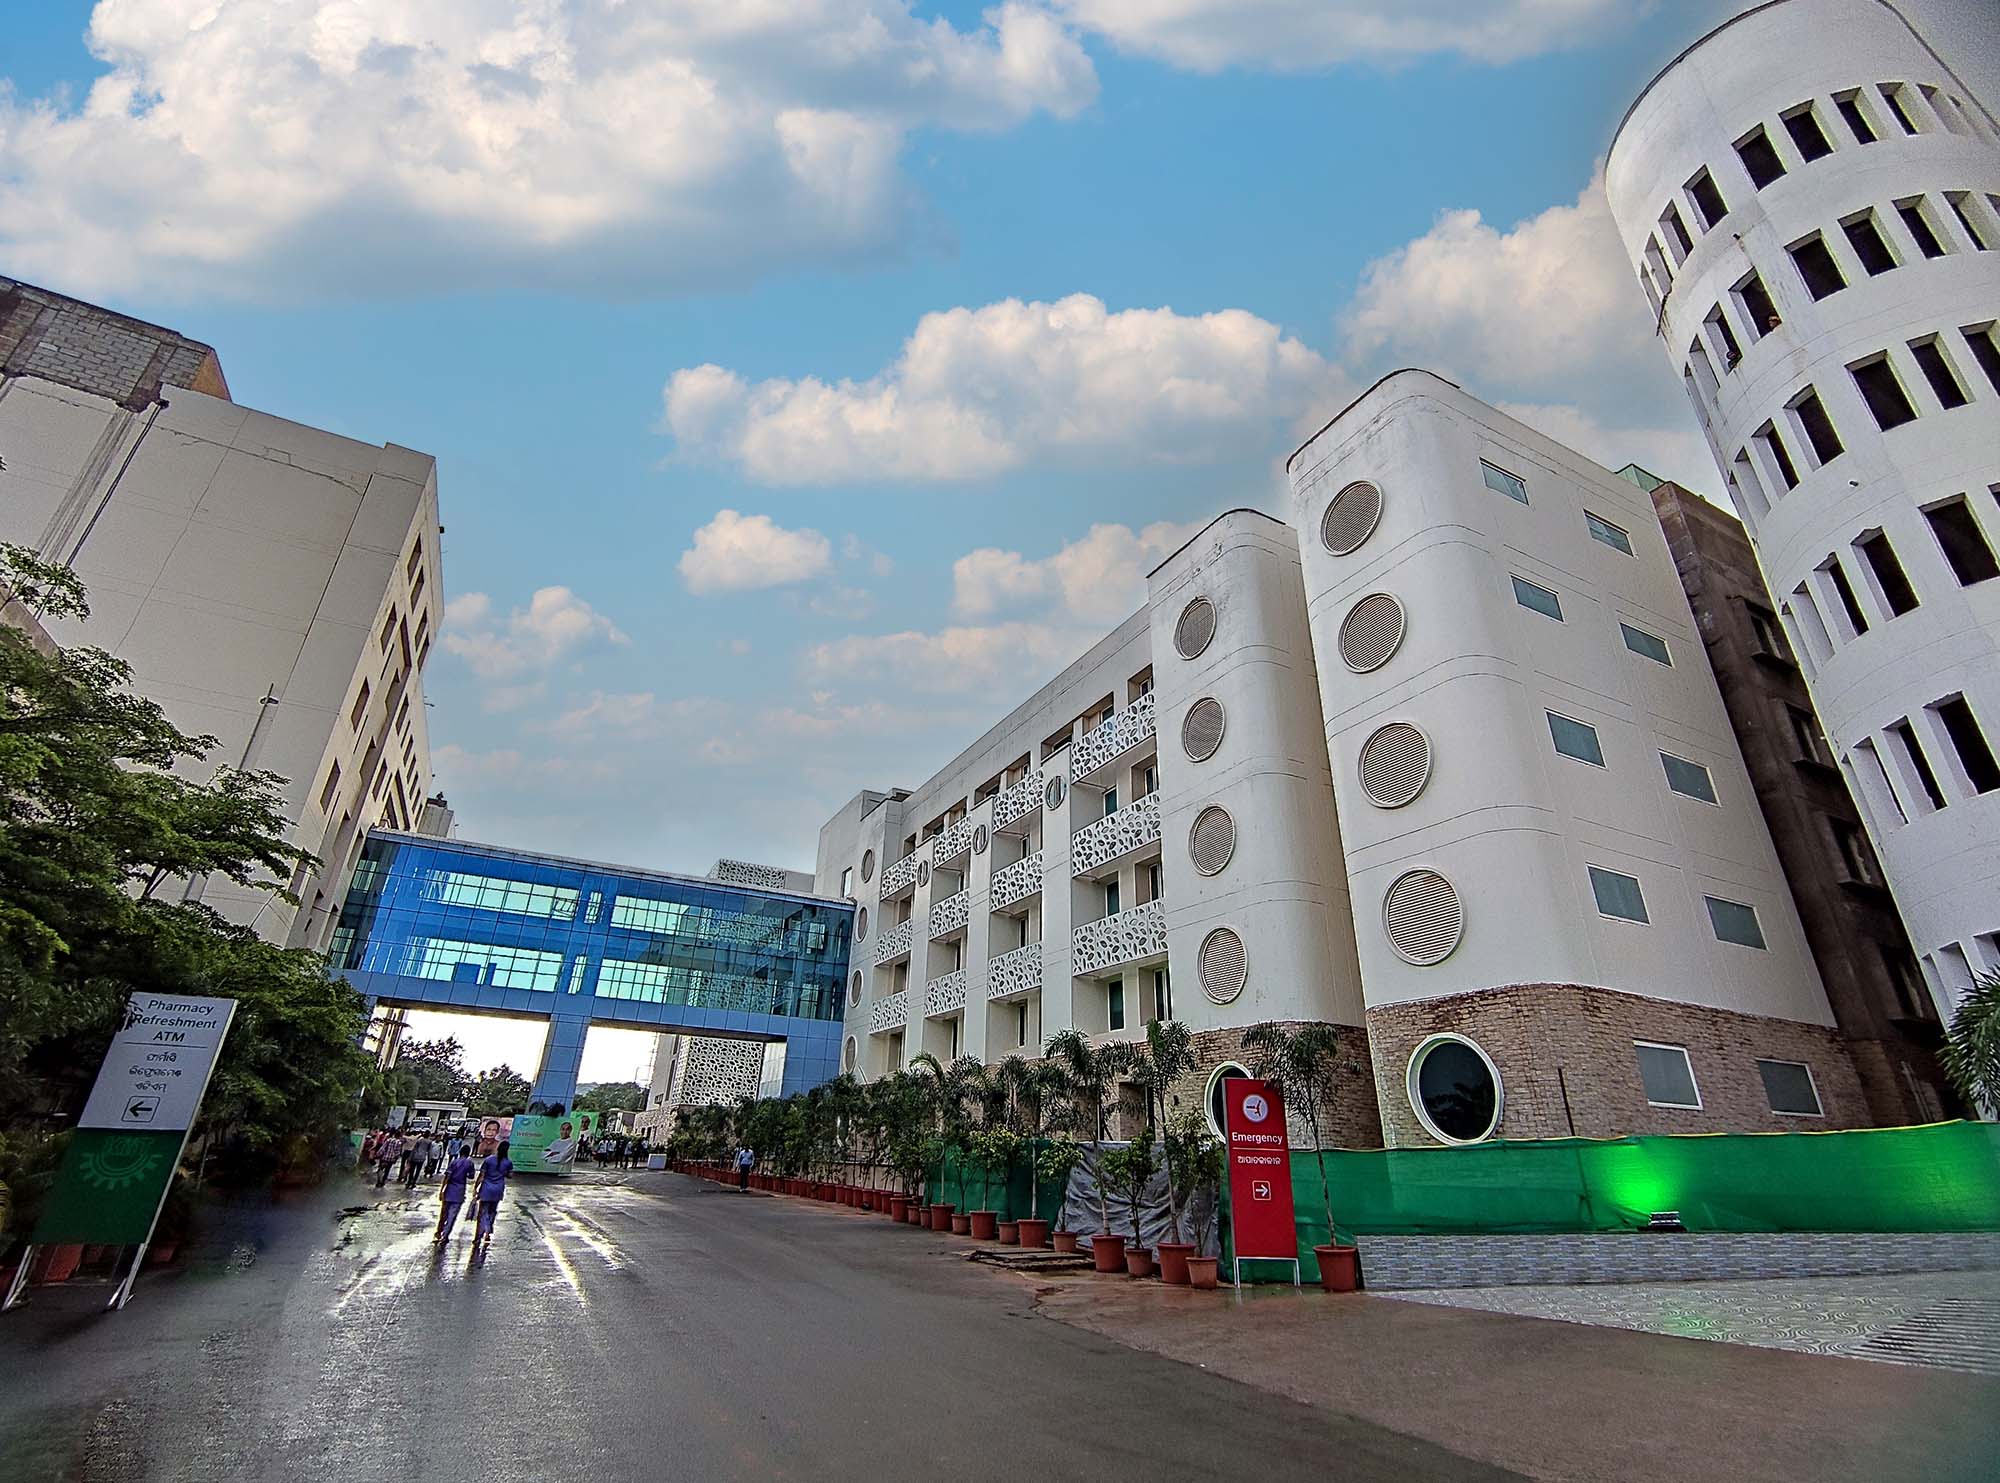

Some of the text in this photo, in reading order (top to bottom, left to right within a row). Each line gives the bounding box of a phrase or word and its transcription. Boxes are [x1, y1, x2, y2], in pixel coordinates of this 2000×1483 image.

[148, 1000, 214, 1016] Pharmacy
[134, 1014, 217, 1029] Refreshment
[153, 1031, 185, 1042] ATM
[1231, 1132, 1283, 1144] Emergency
